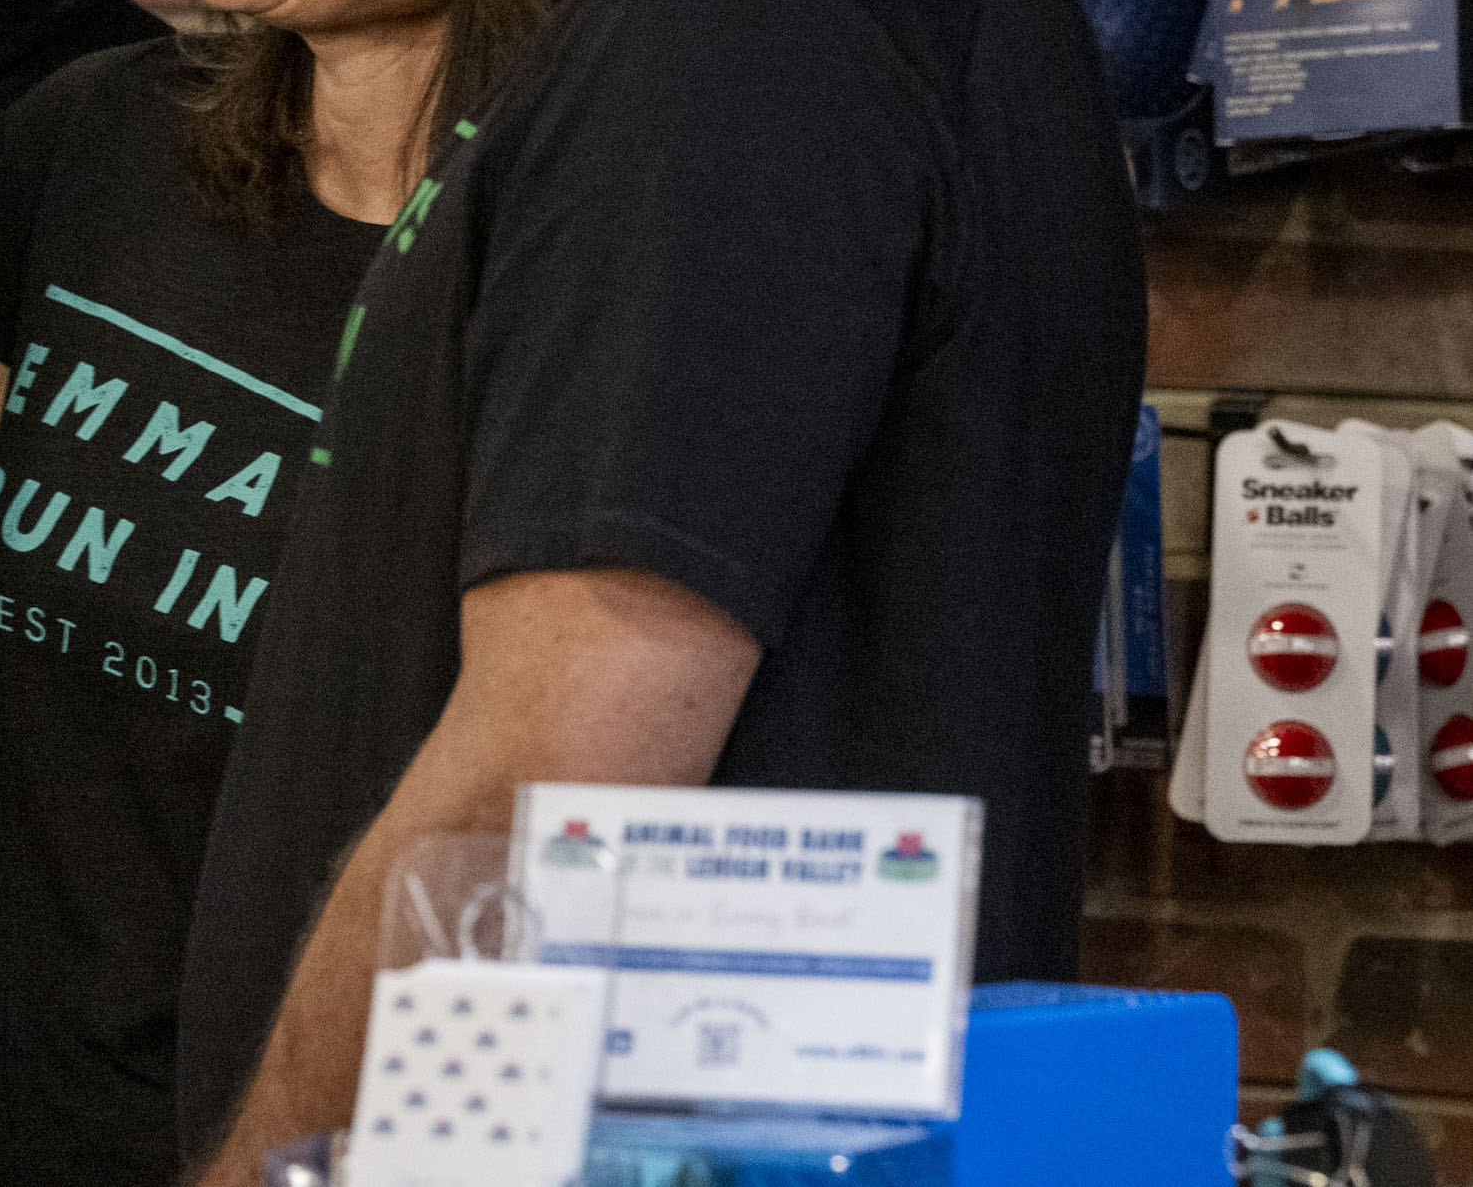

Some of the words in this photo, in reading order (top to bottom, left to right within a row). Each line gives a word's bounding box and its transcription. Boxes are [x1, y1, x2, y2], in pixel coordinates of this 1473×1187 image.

[7, 343, 282, 517] EMMA
[1242, 477, 1358, 502] Sneaker
[1266, 505, 1335, 527] Balls
[153, 548, 270, 643] IN
[102, 641, 212, 715] 2013
